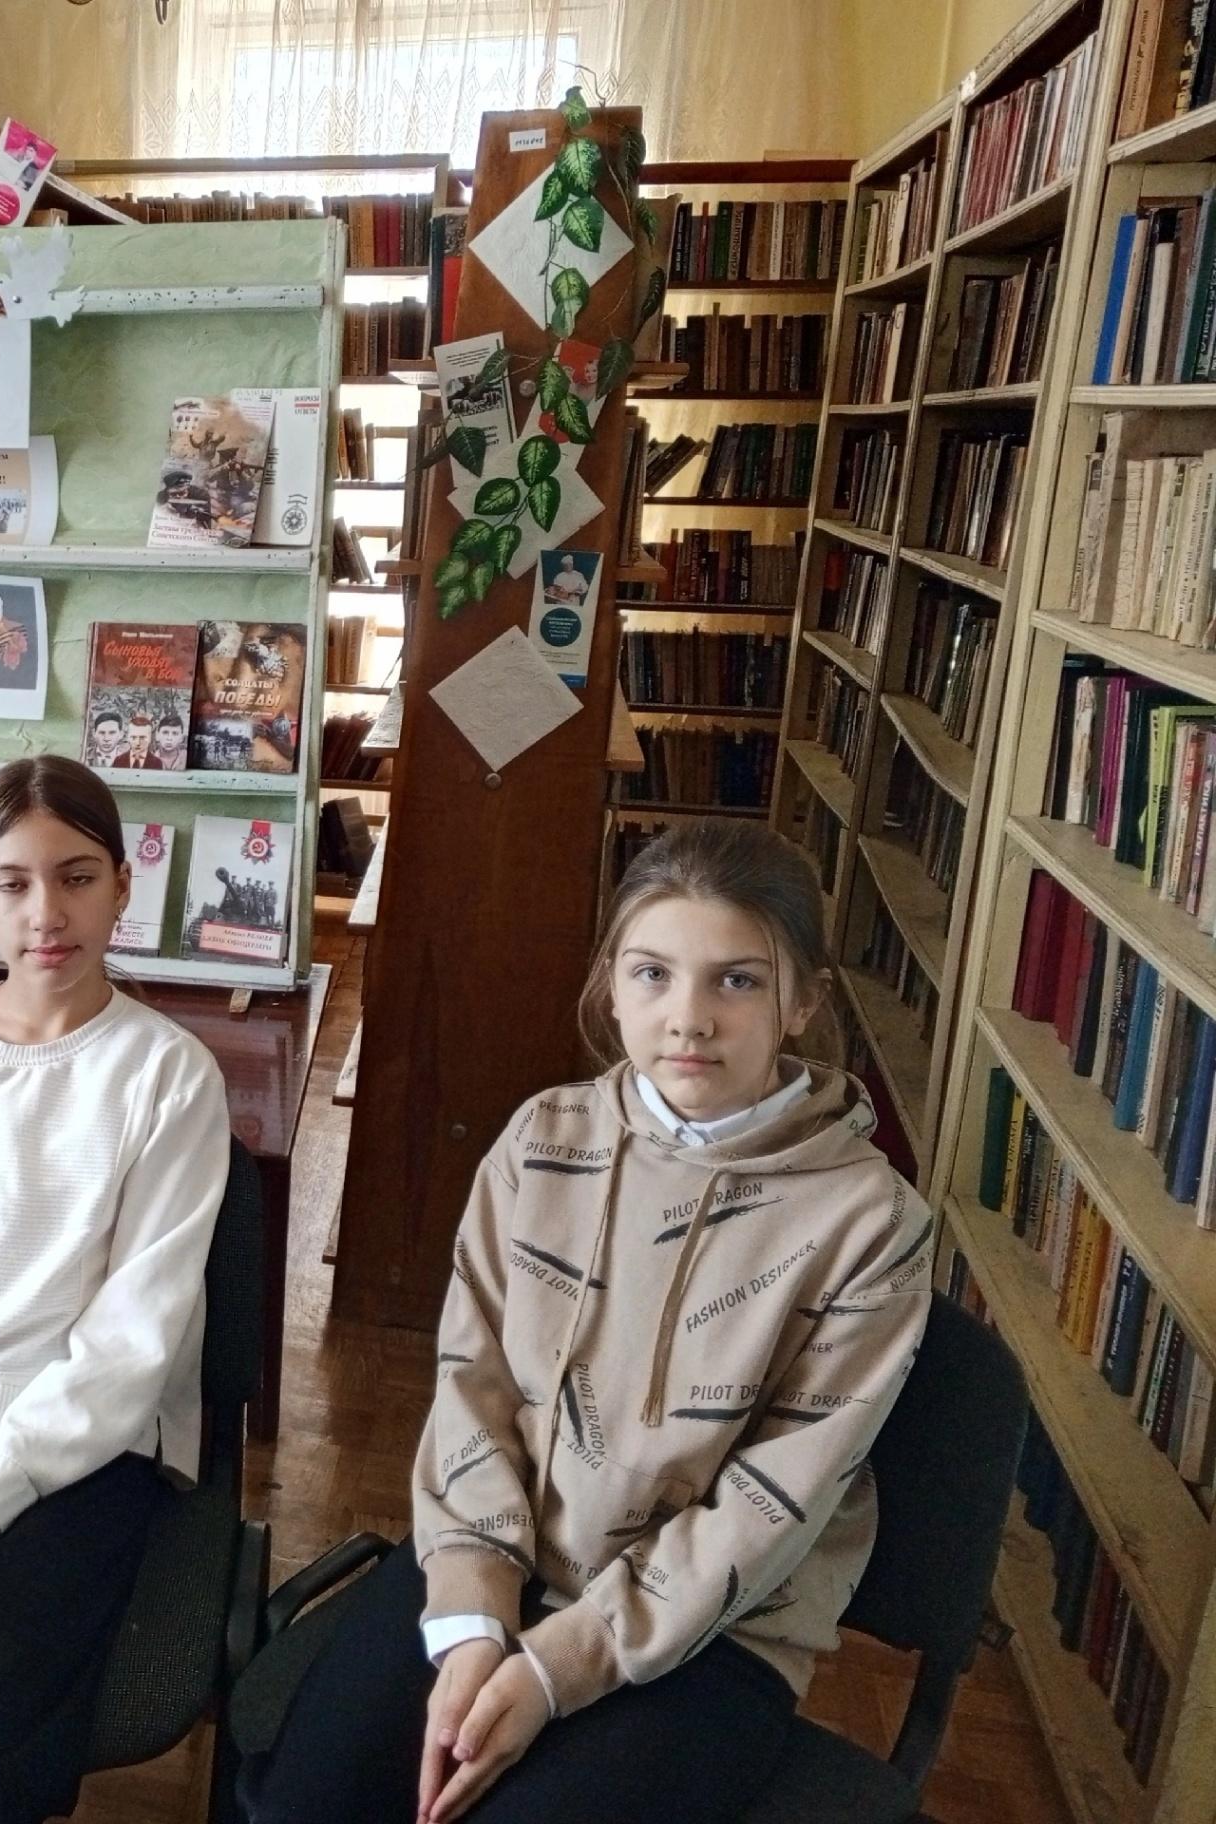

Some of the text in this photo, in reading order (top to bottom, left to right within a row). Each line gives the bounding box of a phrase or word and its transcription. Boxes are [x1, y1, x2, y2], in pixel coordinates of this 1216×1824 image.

[225, 678, 274, 690] СОЛДАТЫ
[214, 690, 281, 708] ПОБЕДЫ
[539, 1101, 590, 1116] DESIGNER
[526, 1141, 612, 1162] PILOT DRAGON
[663, 1182, 763, 1223] PILOT RAGON
[509, 1252, 548, 1280] DRAGO
[889, 1255, 927, 1293] DRAGON
[685, 1240, 817, 1333] FASHION DESIGNER
[690, 1385, 734, 1400] PILOT
[577, 1363, 607, 1461] PILOT DRAGON
[745, 1491, 785, 1525] PILOT
